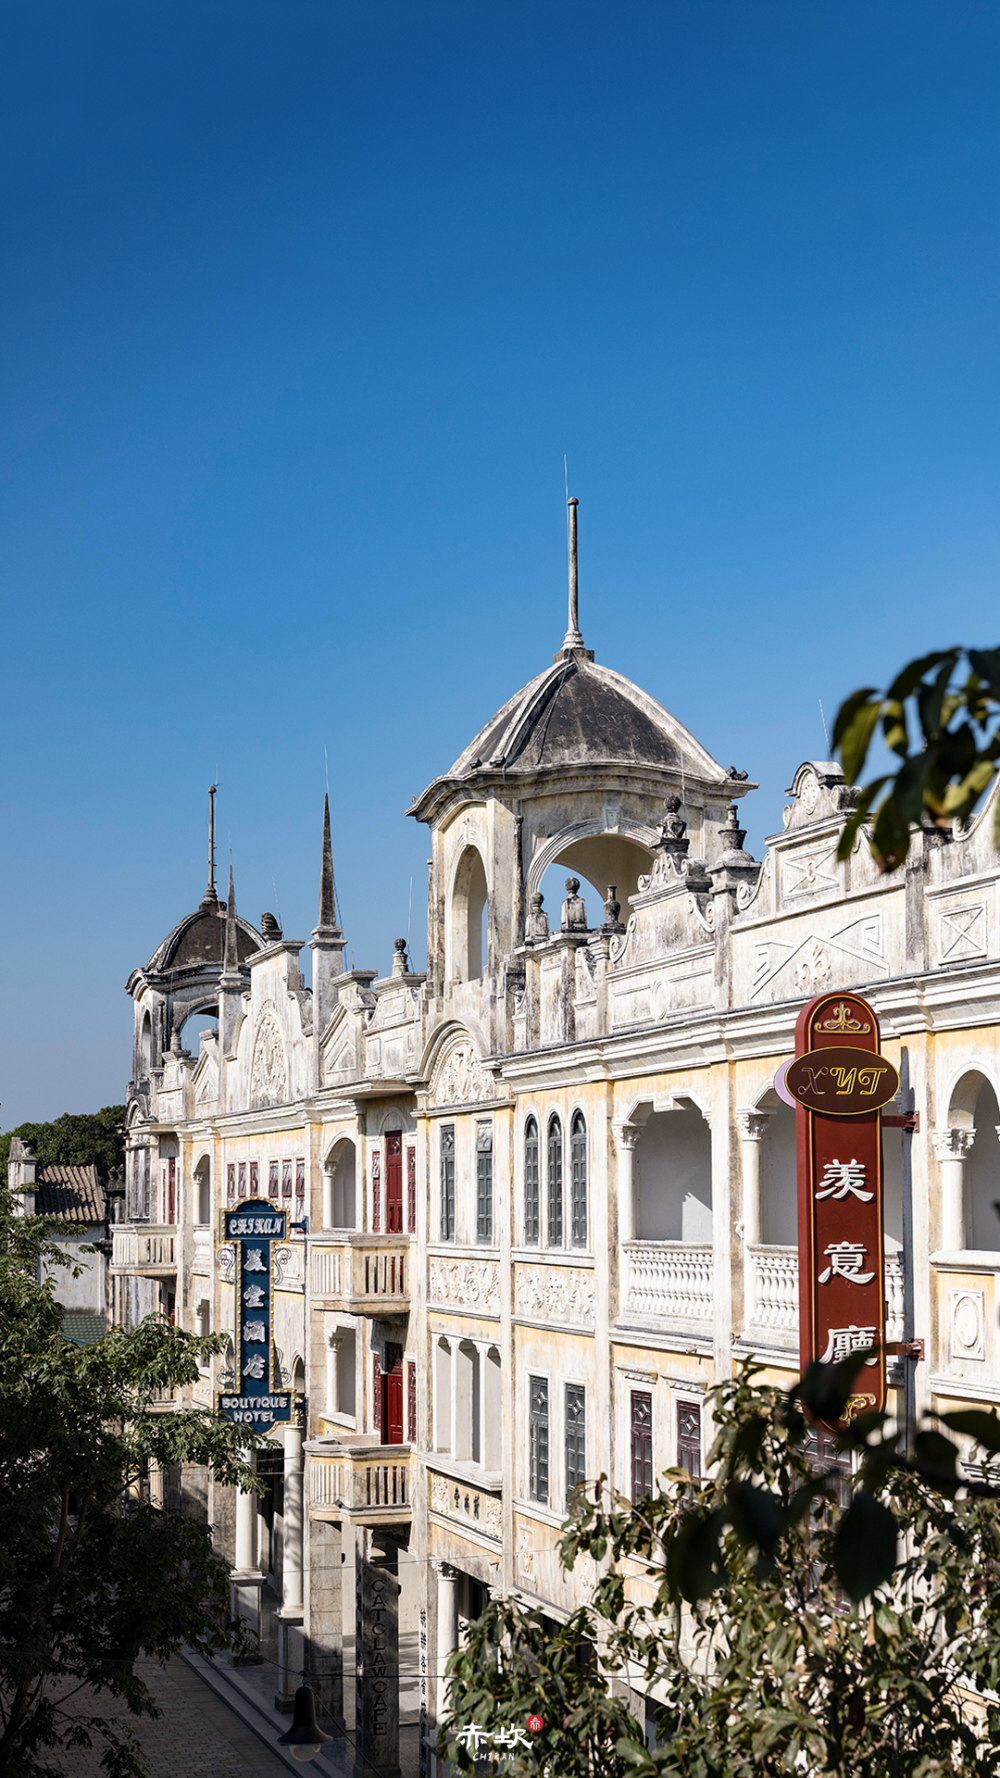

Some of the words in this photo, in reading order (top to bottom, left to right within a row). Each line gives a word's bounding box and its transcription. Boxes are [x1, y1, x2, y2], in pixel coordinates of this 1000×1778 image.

[797, 1066, 888, 1096] XYT
[221, 1396, 288, 1409] BOUTIQUE
[233, 1410, 276, 1423] HOTEL
